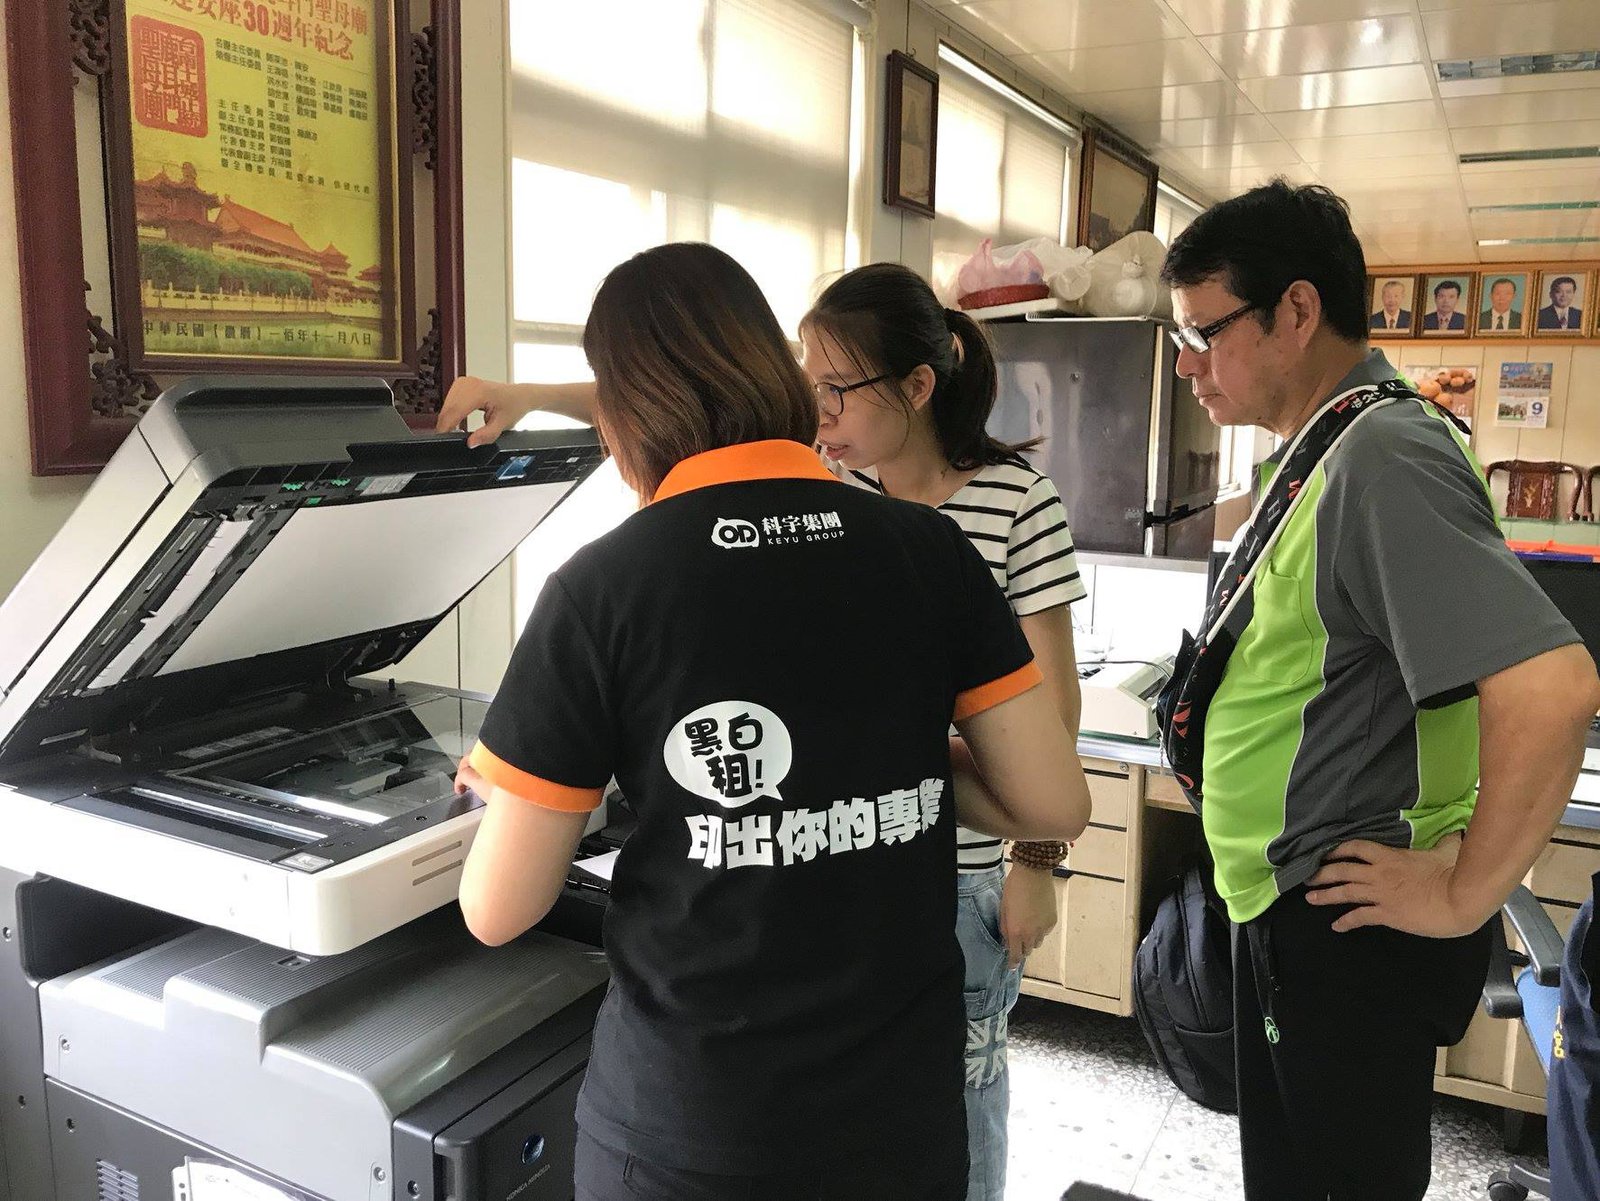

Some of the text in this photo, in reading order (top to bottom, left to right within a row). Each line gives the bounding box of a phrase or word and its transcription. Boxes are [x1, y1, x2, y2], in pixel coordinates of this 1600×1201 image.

[1531, 401, 1543, 415] 9
[761, 511, 842, 535] 科宇集團
[767, 530, 845, 545] KEYU GROUP
[684, 712, 764, 758] 黑白
[684, 777, 946, 869] 印出你的專業
